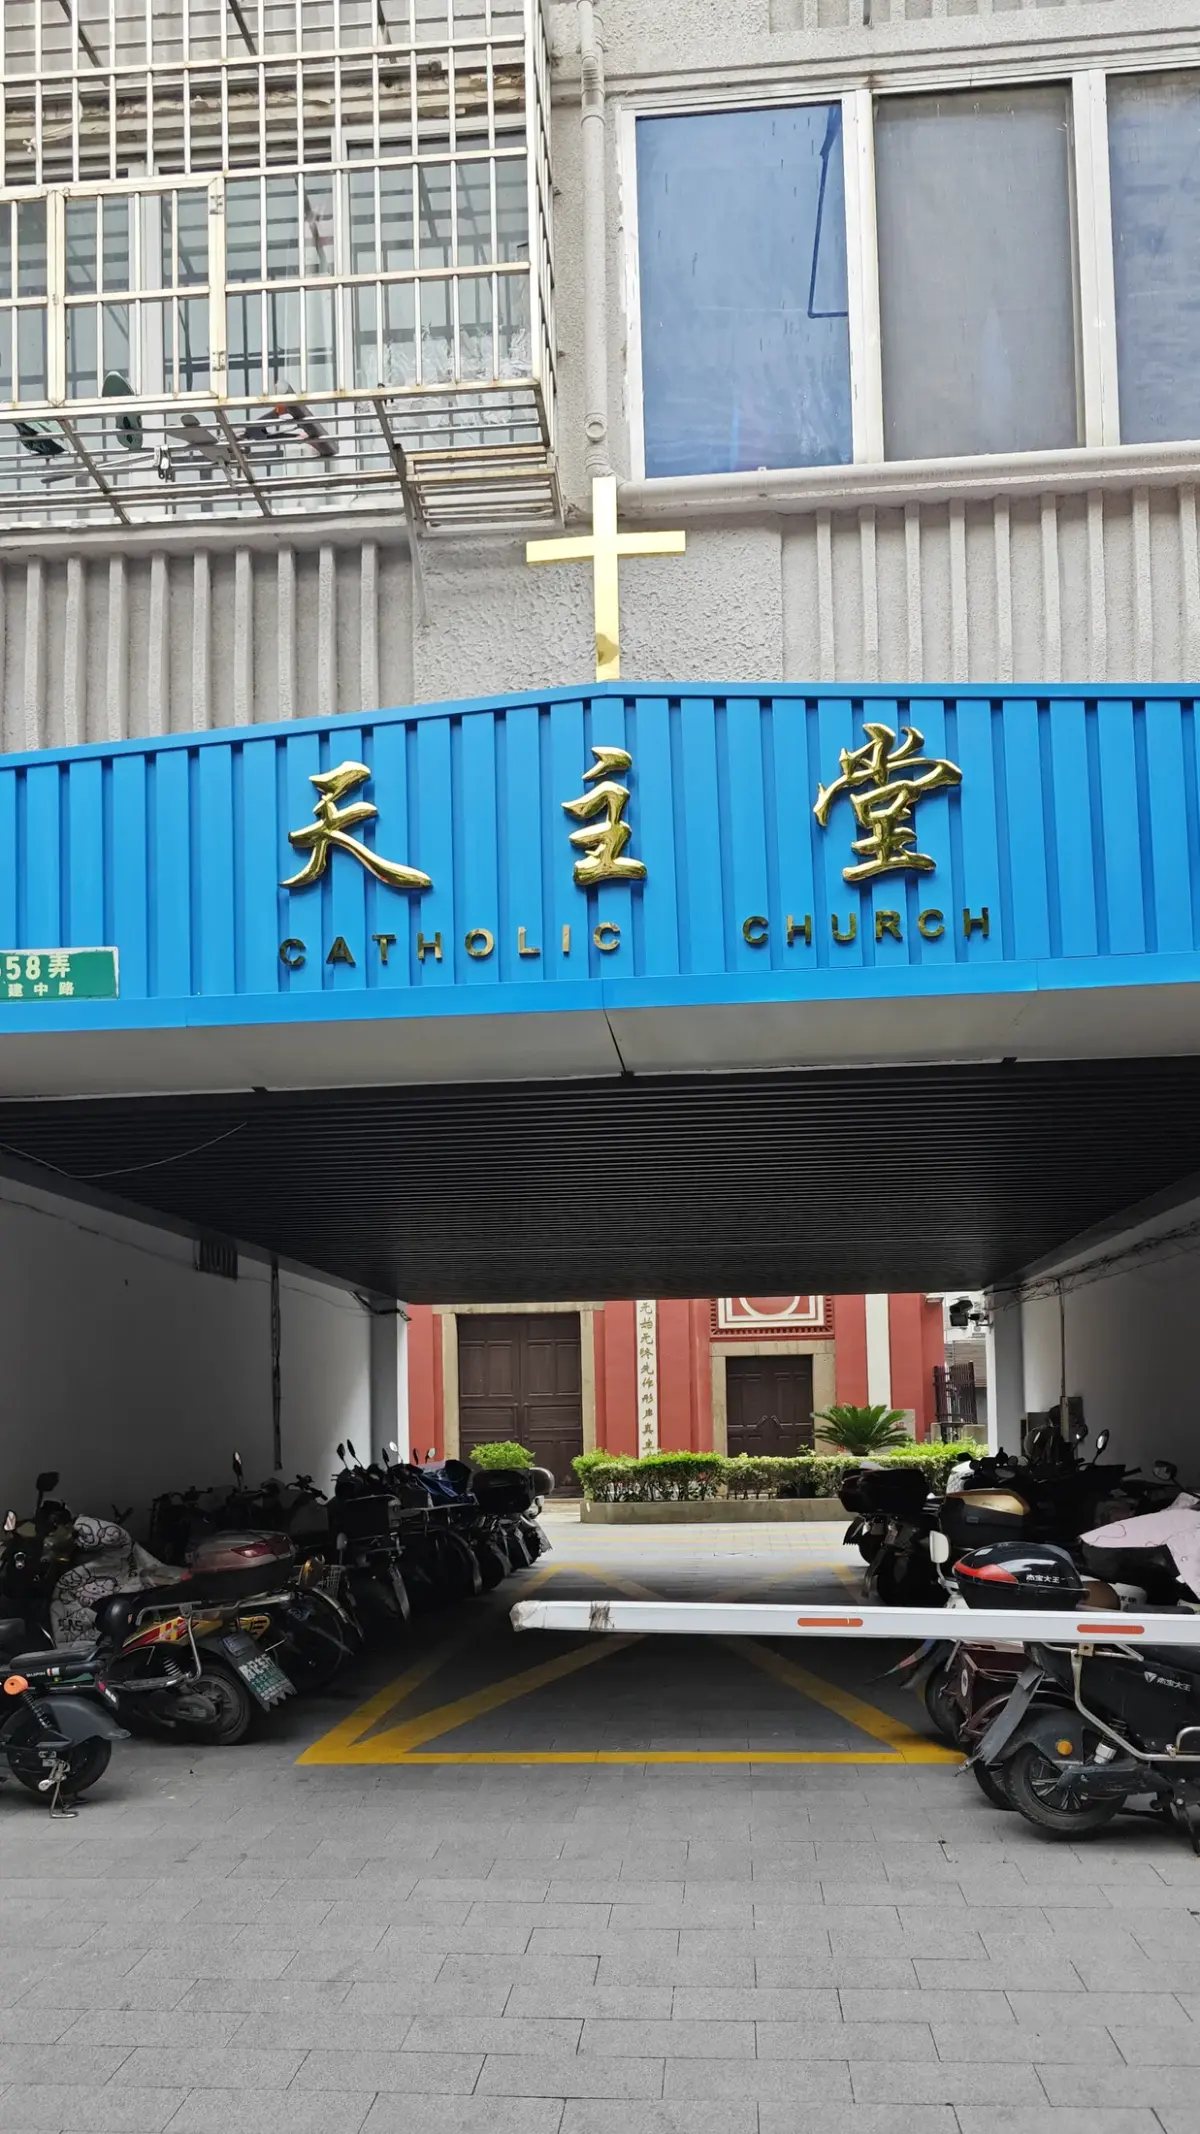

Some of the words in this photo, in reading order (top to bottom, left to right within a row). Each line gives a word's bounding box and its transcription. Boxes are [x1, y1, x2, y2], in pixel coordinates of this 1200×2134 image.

[279, 722, 963, 890] 天主堂
[0, 953, 71, 980] 58弄
[279, 922, 621, 968] CATHOLIC
[742, 906, 990, 946] CHURCH
